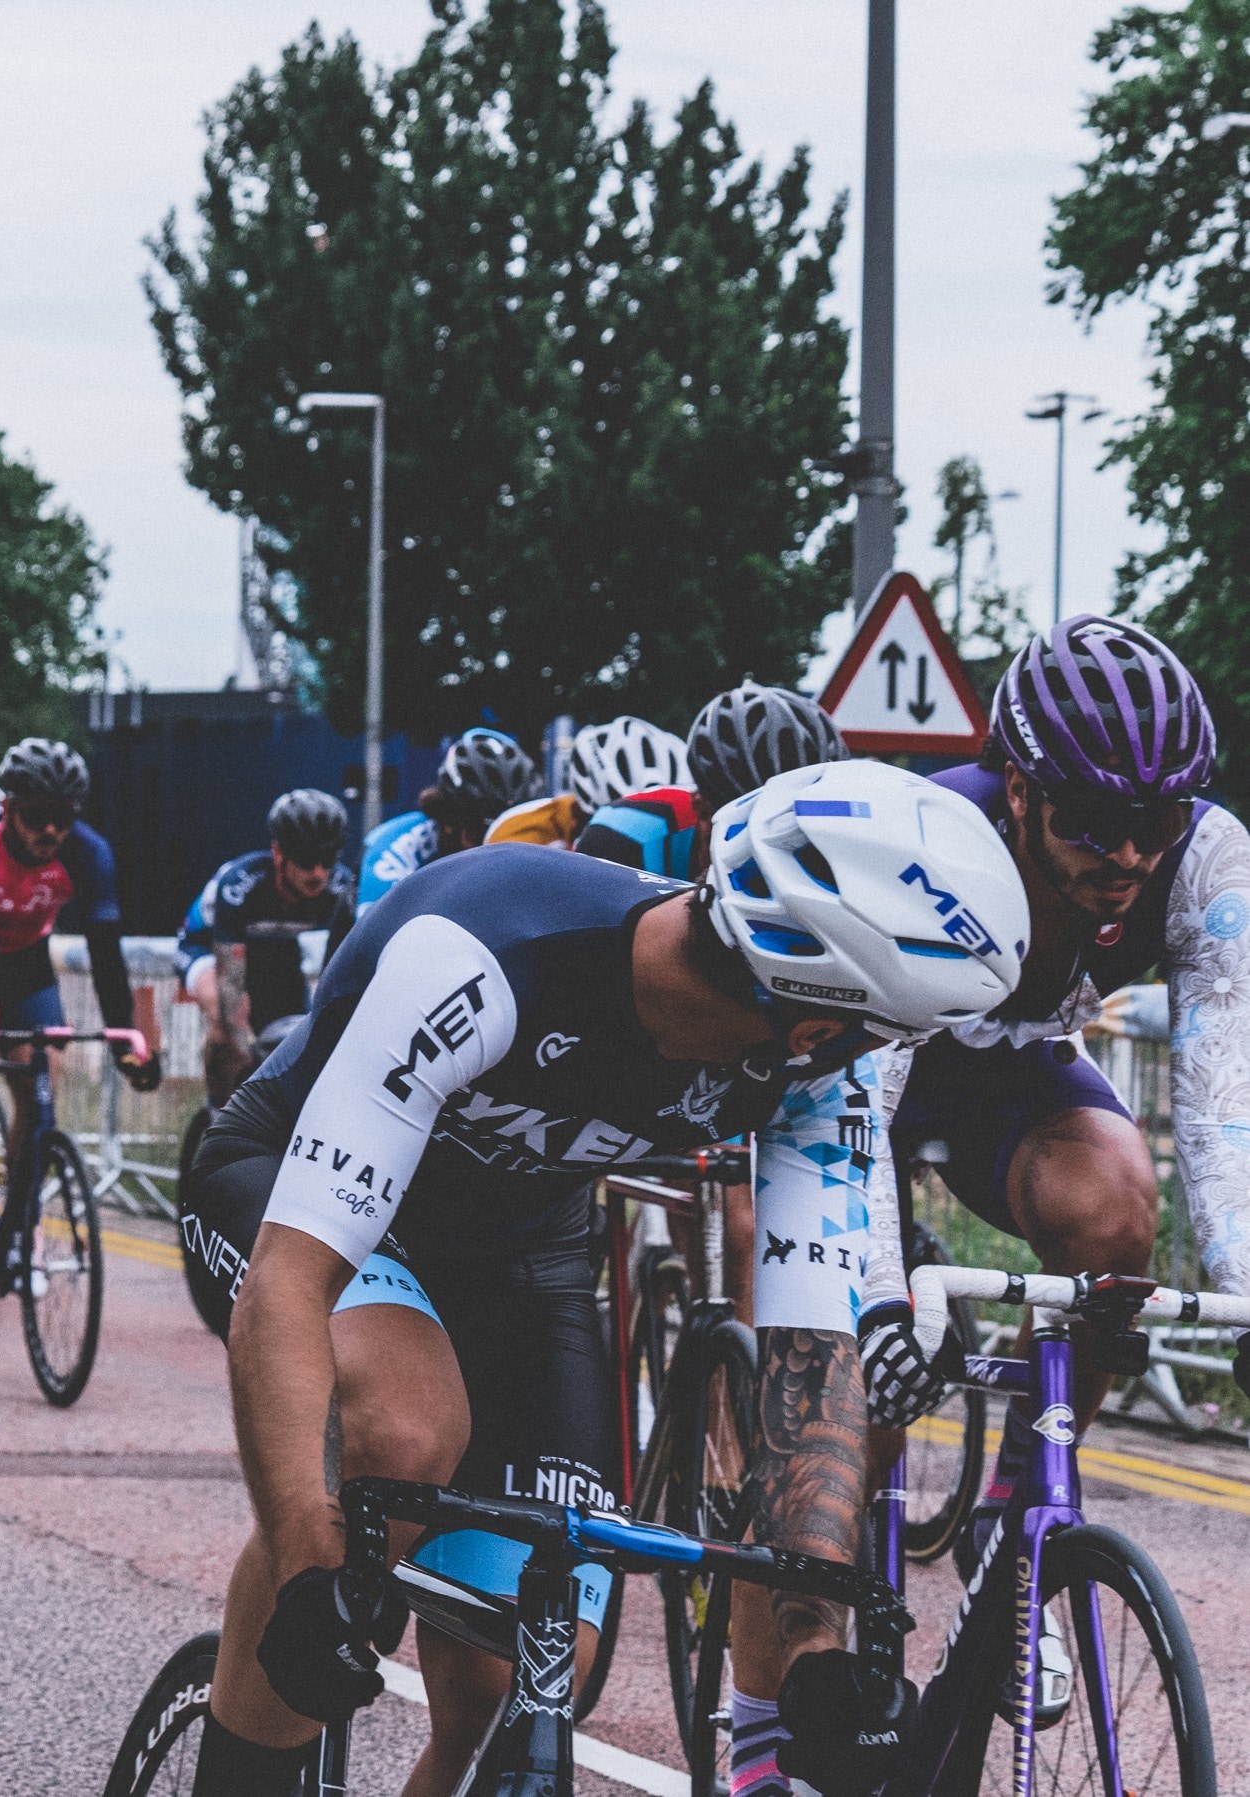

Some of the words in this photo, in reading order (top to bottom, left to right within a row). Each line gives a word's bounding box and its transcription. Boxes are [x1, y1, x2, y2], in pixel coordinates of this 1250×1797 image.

[1010, 703, 1045, 760] LAZER
[897, 862, 1002, 957] MET
[382, 972, 486, 1104] MET
[290, 1134, 406, 1205] RIVAL
